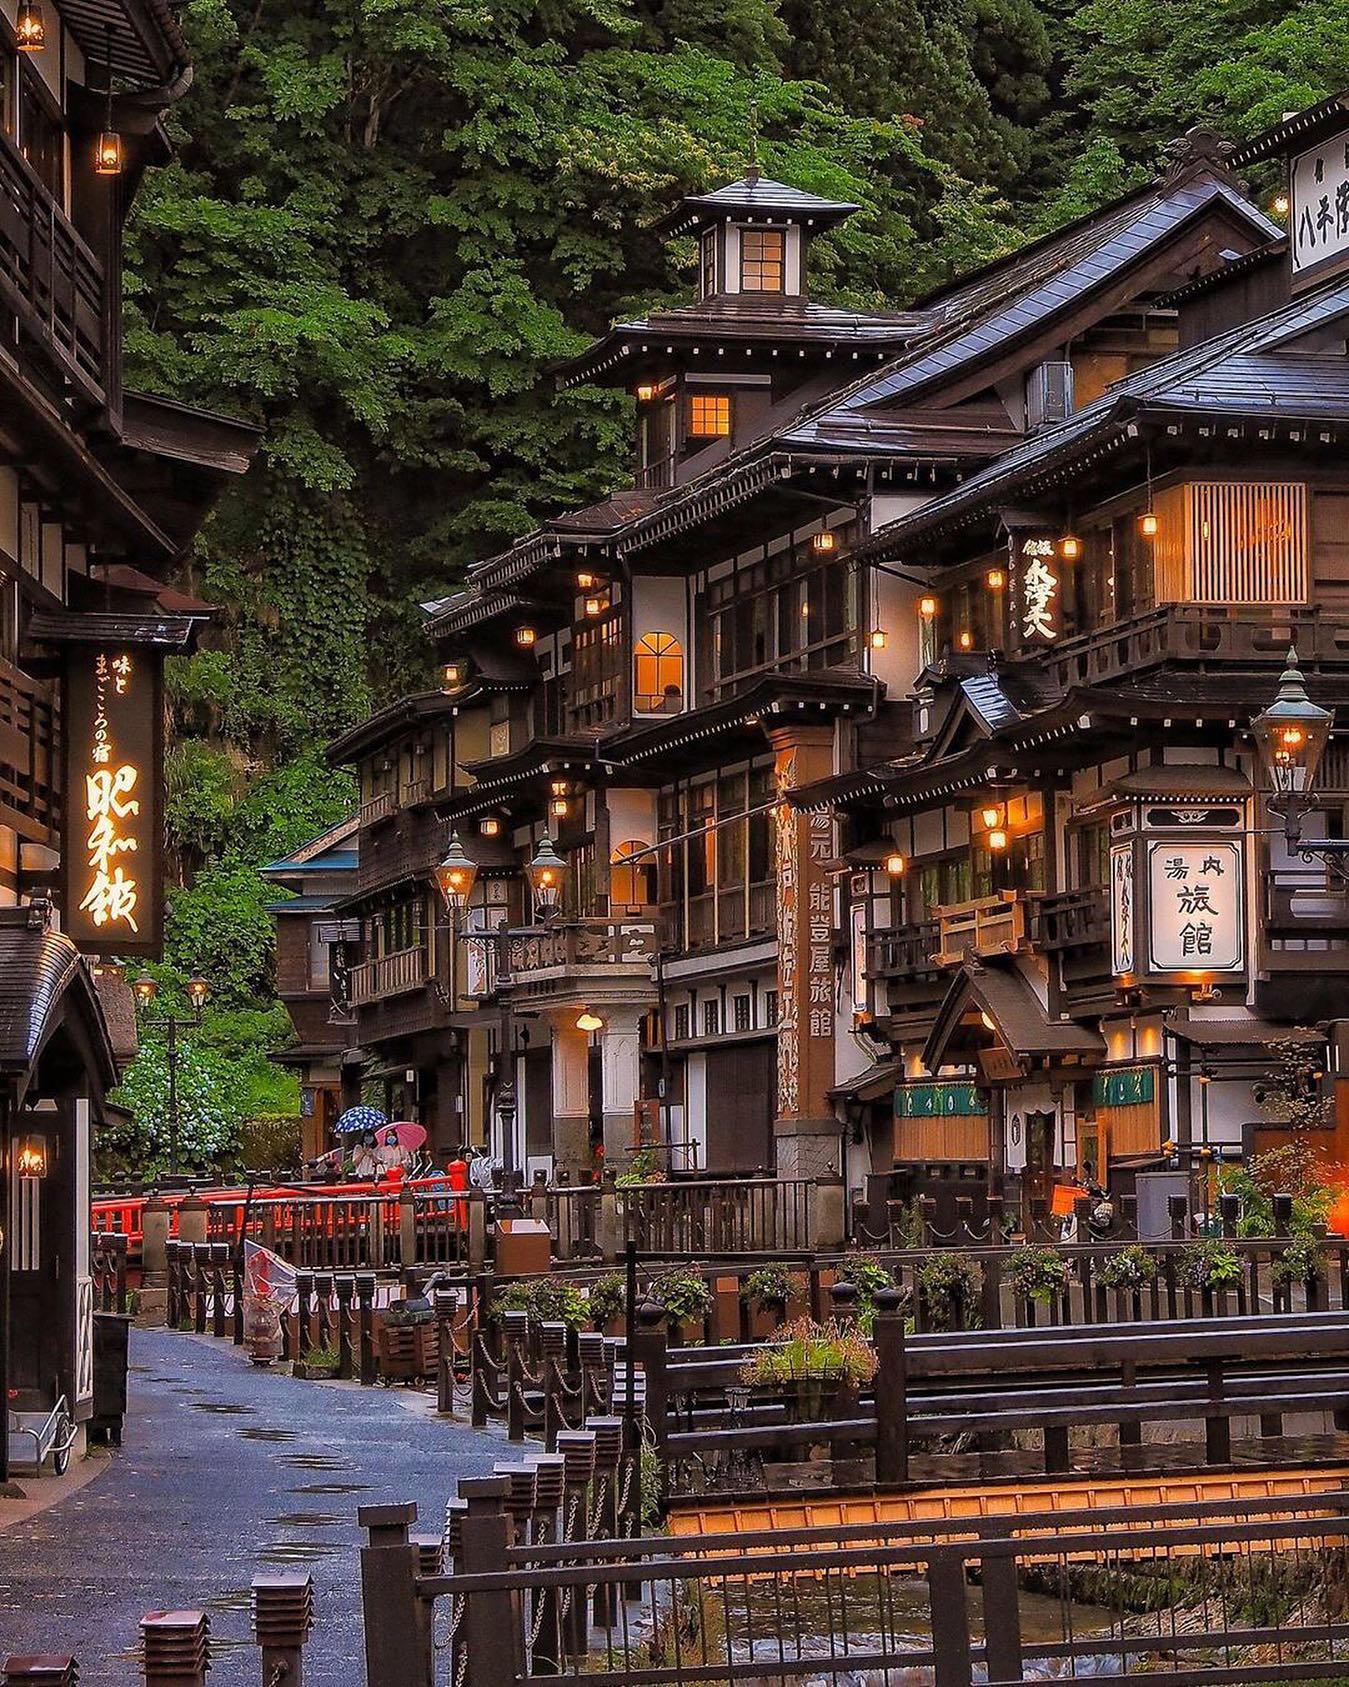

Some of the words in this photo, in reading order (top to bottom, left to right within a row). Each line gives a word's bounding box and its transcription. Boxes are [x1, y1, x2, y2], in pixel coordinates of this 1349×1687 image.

[91, 653, 112, 763] まごころの宿
[112, 655, 132, 694] 味と
[80, 764, 139, 933] 昭和館
[809, 882, 832, 1037] 能登屋旅館
[1177, 885, 1219, 957] 旅館
